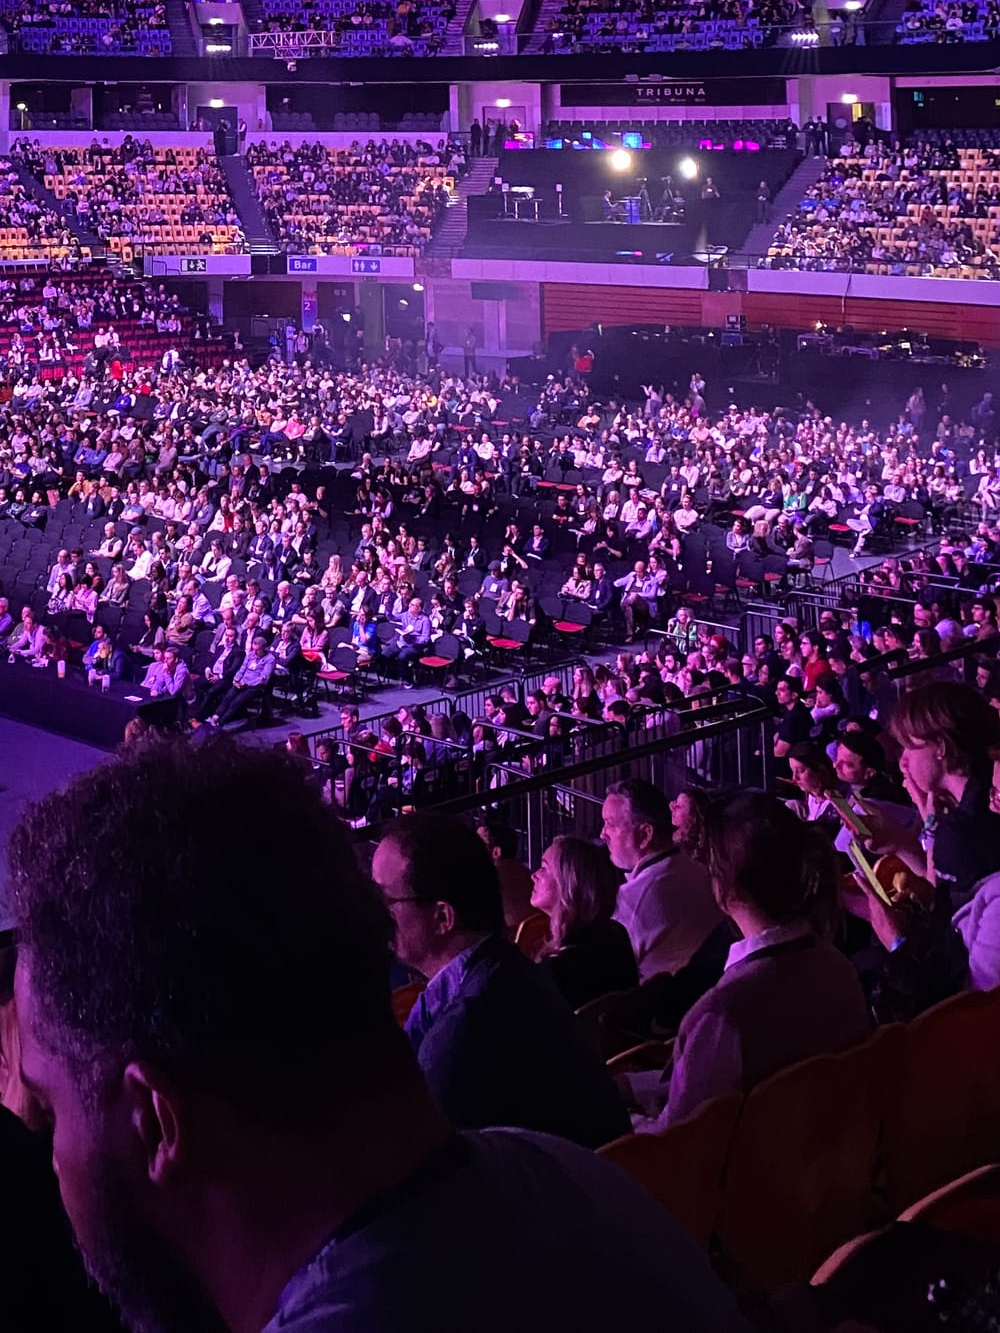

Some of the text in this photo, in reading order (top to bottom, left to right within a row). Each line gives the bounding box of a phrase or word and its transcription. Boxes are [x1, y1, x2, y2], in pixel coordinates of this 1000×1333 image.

[636, 87, 706, 96] TRIBUNA
[293, 260, 312, 270] Bar
[303, 301, 311, 311] 2
